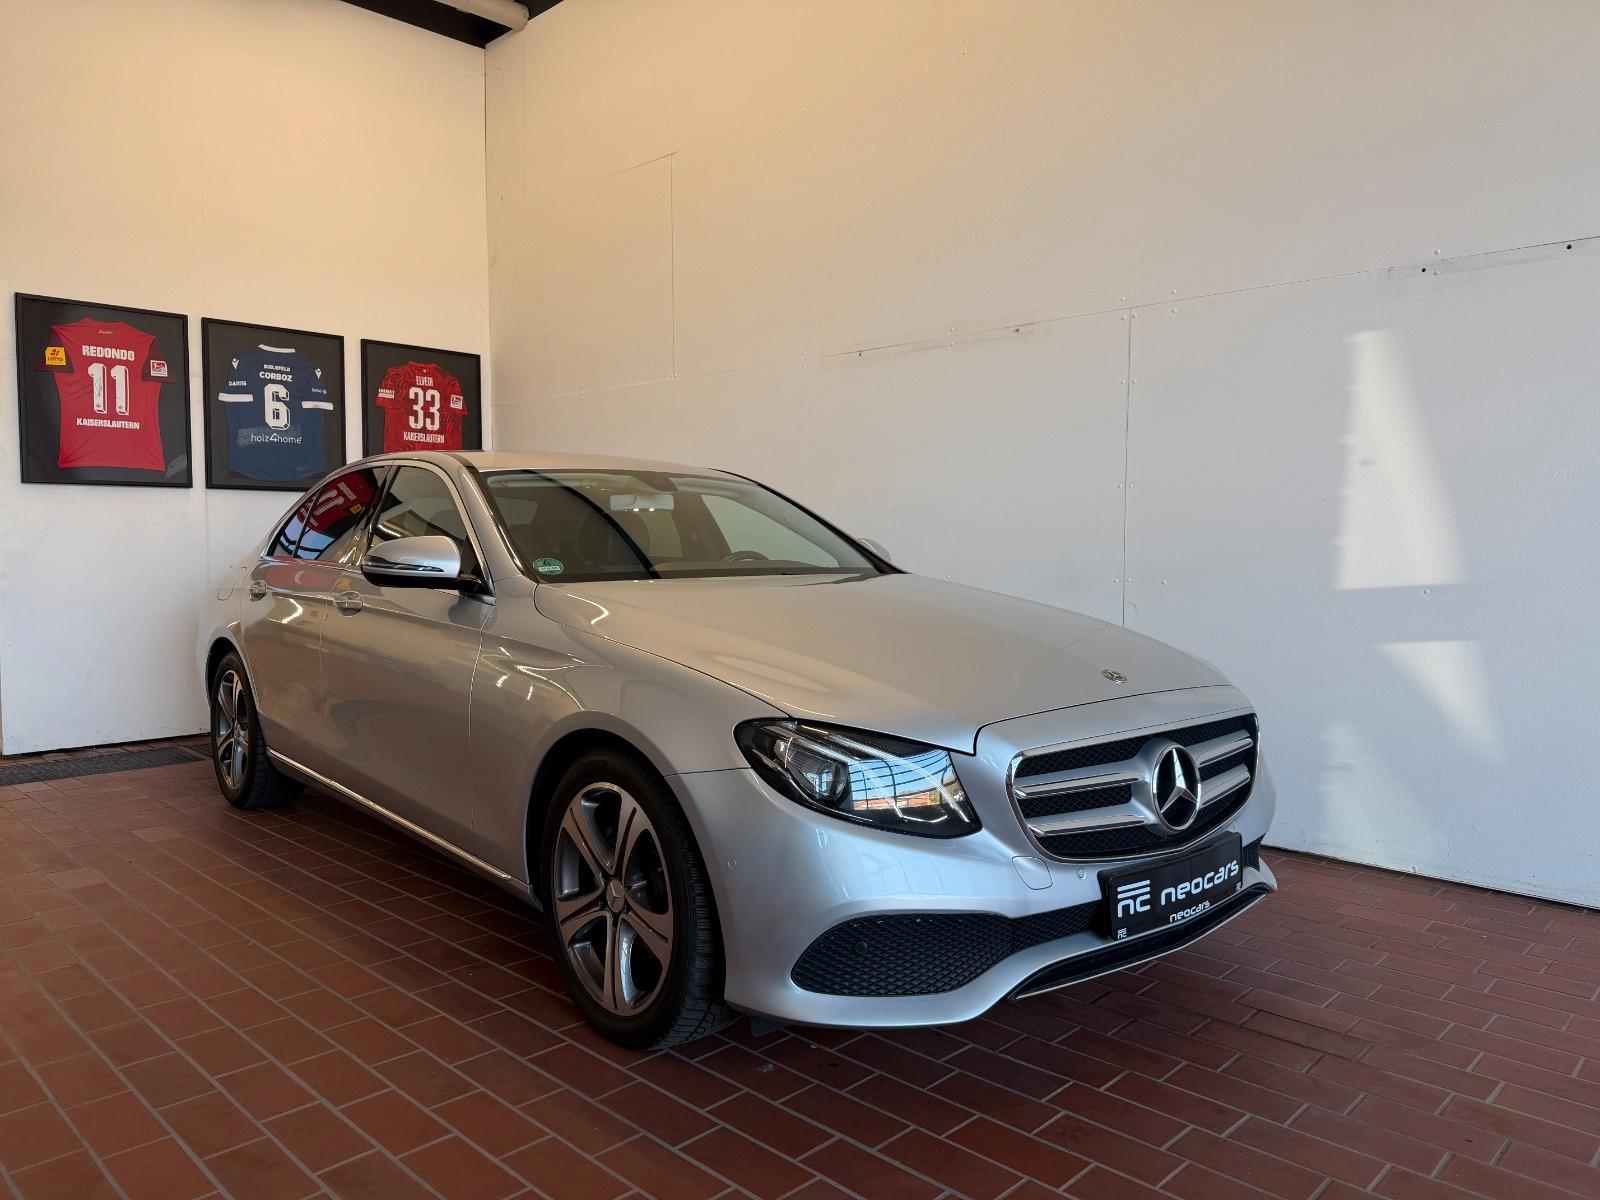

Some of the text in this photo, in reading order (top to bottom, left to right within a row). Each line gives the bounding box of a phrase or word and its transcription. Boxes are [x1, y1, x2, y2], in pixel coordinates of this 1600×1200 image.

[82, 345, 135, 361] REDONDO
[263, 364, 291, 372] BIELEFELD
[259, 371, 293, 382] CORBOZ
[88, 362, 129, 416] 11
[264, 383, 291, 431] 6
[408, 386, 441, 431] 33
[76, 418, 140, 430] KAISERSLAUTERN
[250, 433, 303, 444] holz4home
[403, 431, 445, 444] KAISERSLAUTERN
[1160, 859, 1239, 906] neocars
[1169, 900, 1211, 923] neocars
